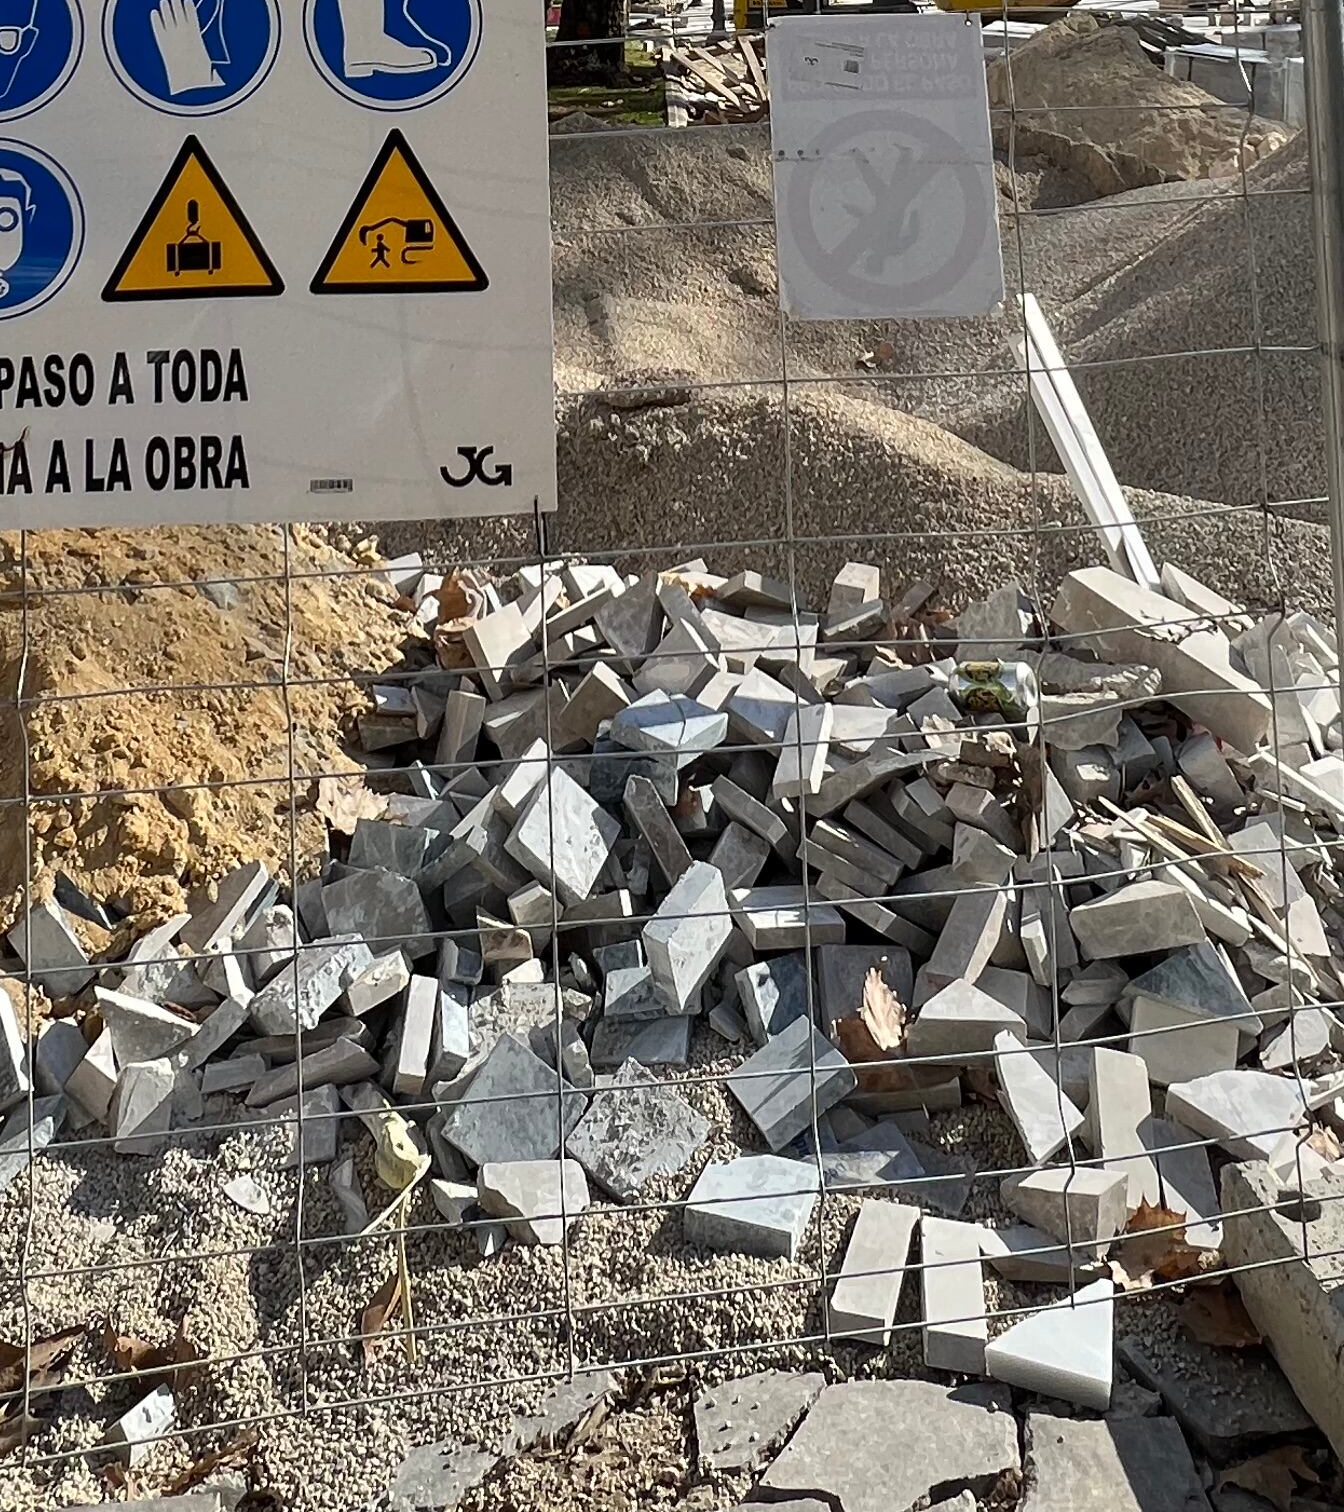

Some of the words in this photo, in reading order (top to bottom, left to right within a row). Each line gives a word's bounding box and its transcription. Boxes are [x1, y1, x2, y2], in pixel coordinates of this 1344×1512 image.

[108, 352, 135, 405] A
[146, 348, 249, 404] TODA
[45, 439, 71, 494] A
[85, 437, 133, 492] LA
[145, 434, 251, 492] OBRA
